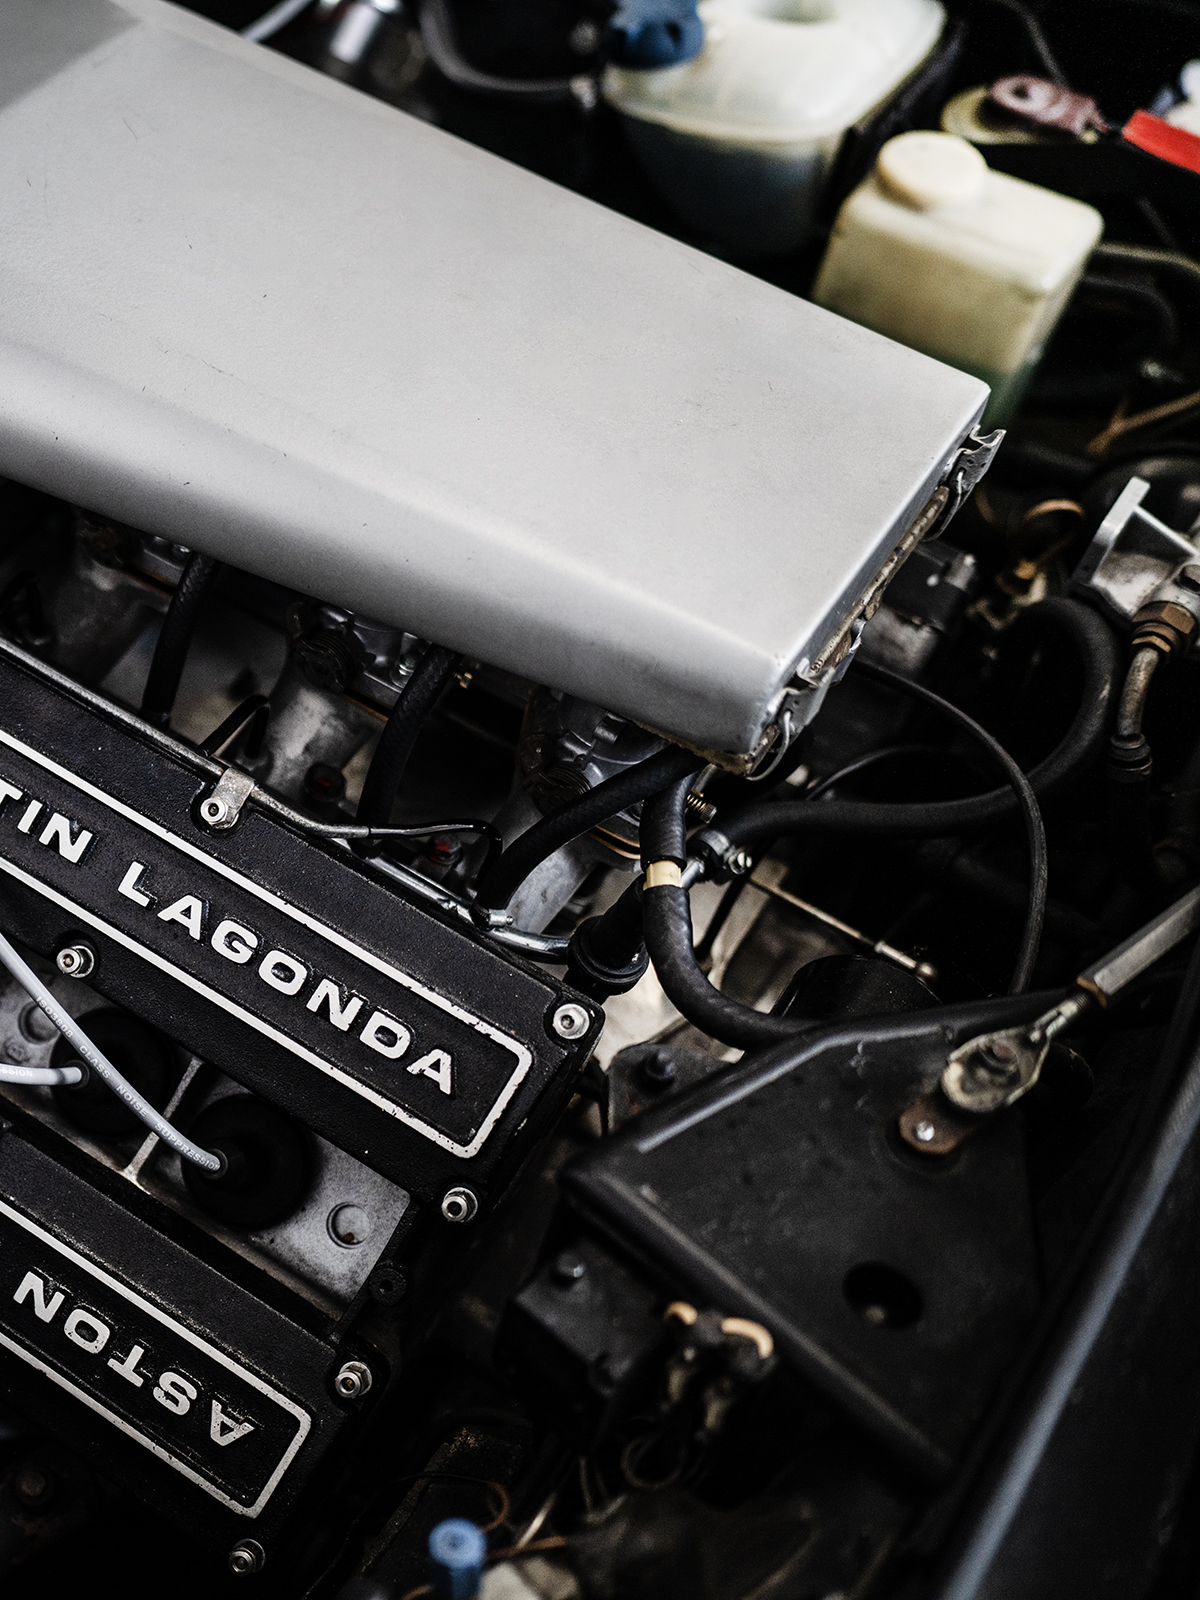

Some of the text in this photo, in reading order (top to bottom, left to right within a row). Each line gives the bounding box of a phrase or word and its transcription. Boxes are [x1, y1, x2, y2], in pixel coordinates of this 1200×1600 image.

[36, 996, 74, 1038] ISO3808
[79, 1045, 110, 1079] CLASS
[116, 1084, 148, 1118] NOISE
[117, 861, 454, 1096] LAGONDA
[13, 1271, 255, 1447] ASTON
